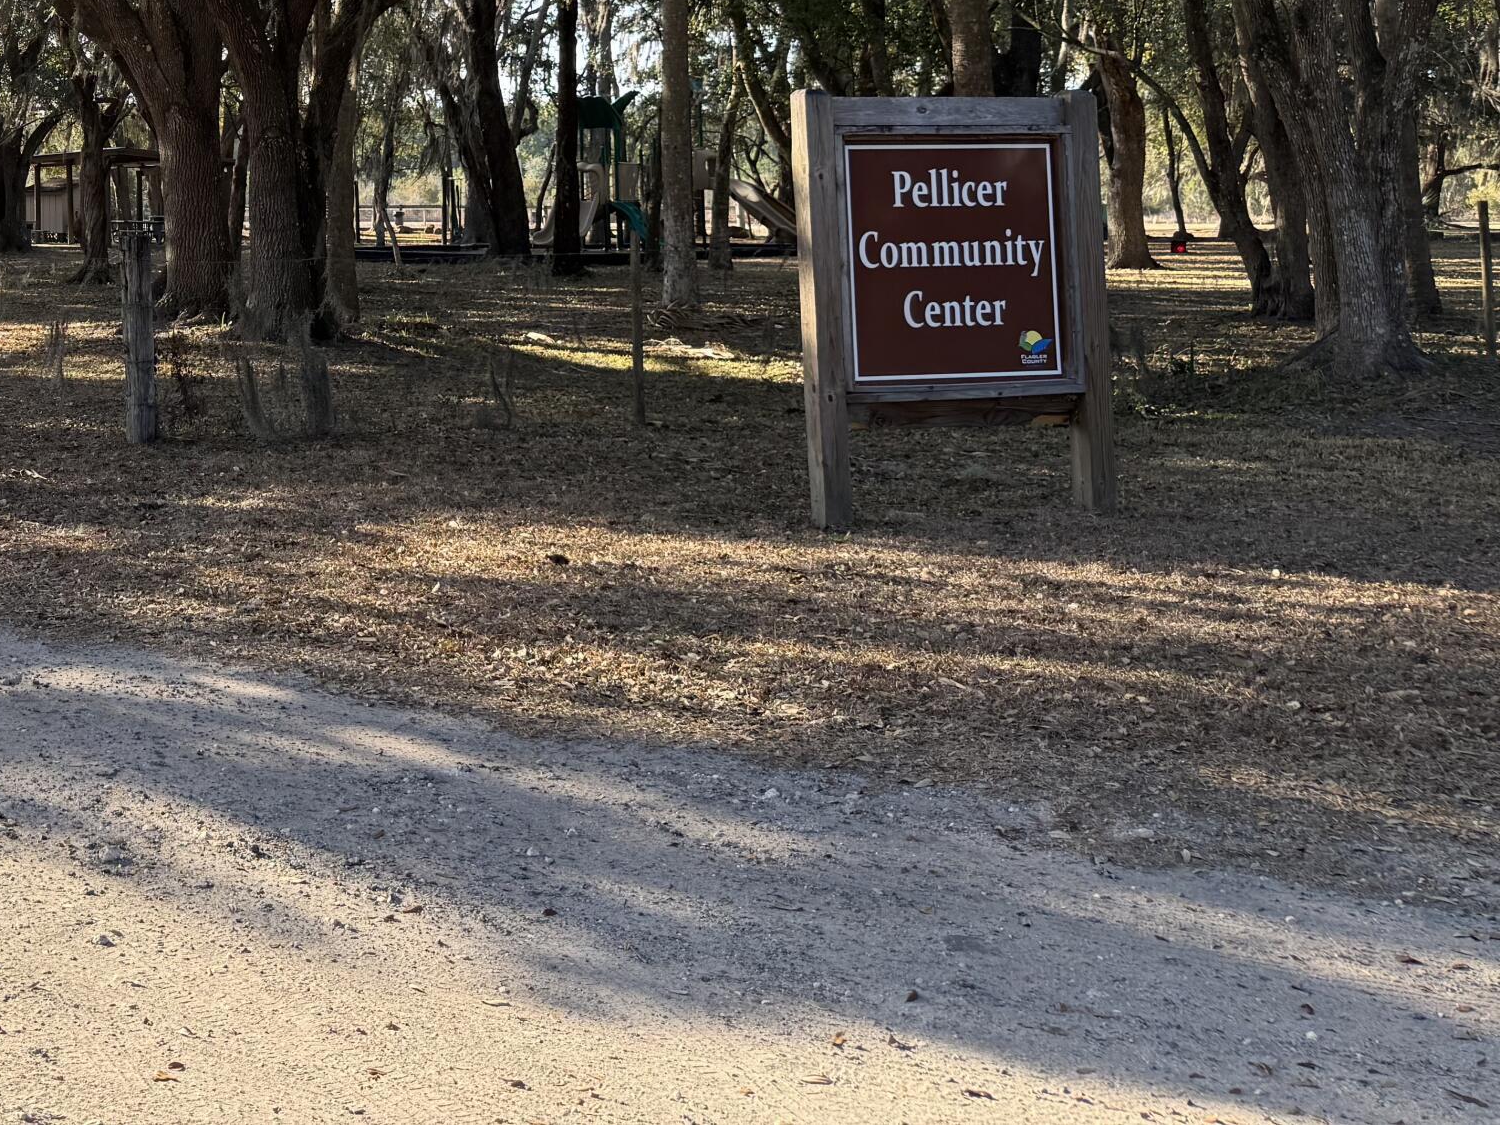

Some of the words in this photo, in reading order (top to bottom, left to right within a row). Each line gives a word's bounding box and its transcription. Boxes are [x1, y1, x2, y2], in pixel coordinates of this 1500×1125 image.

[891, 168, 1007, 208] Pellicer
[858, 229, 1044, 277] Community
[903, 290, 1006, 328] Center
